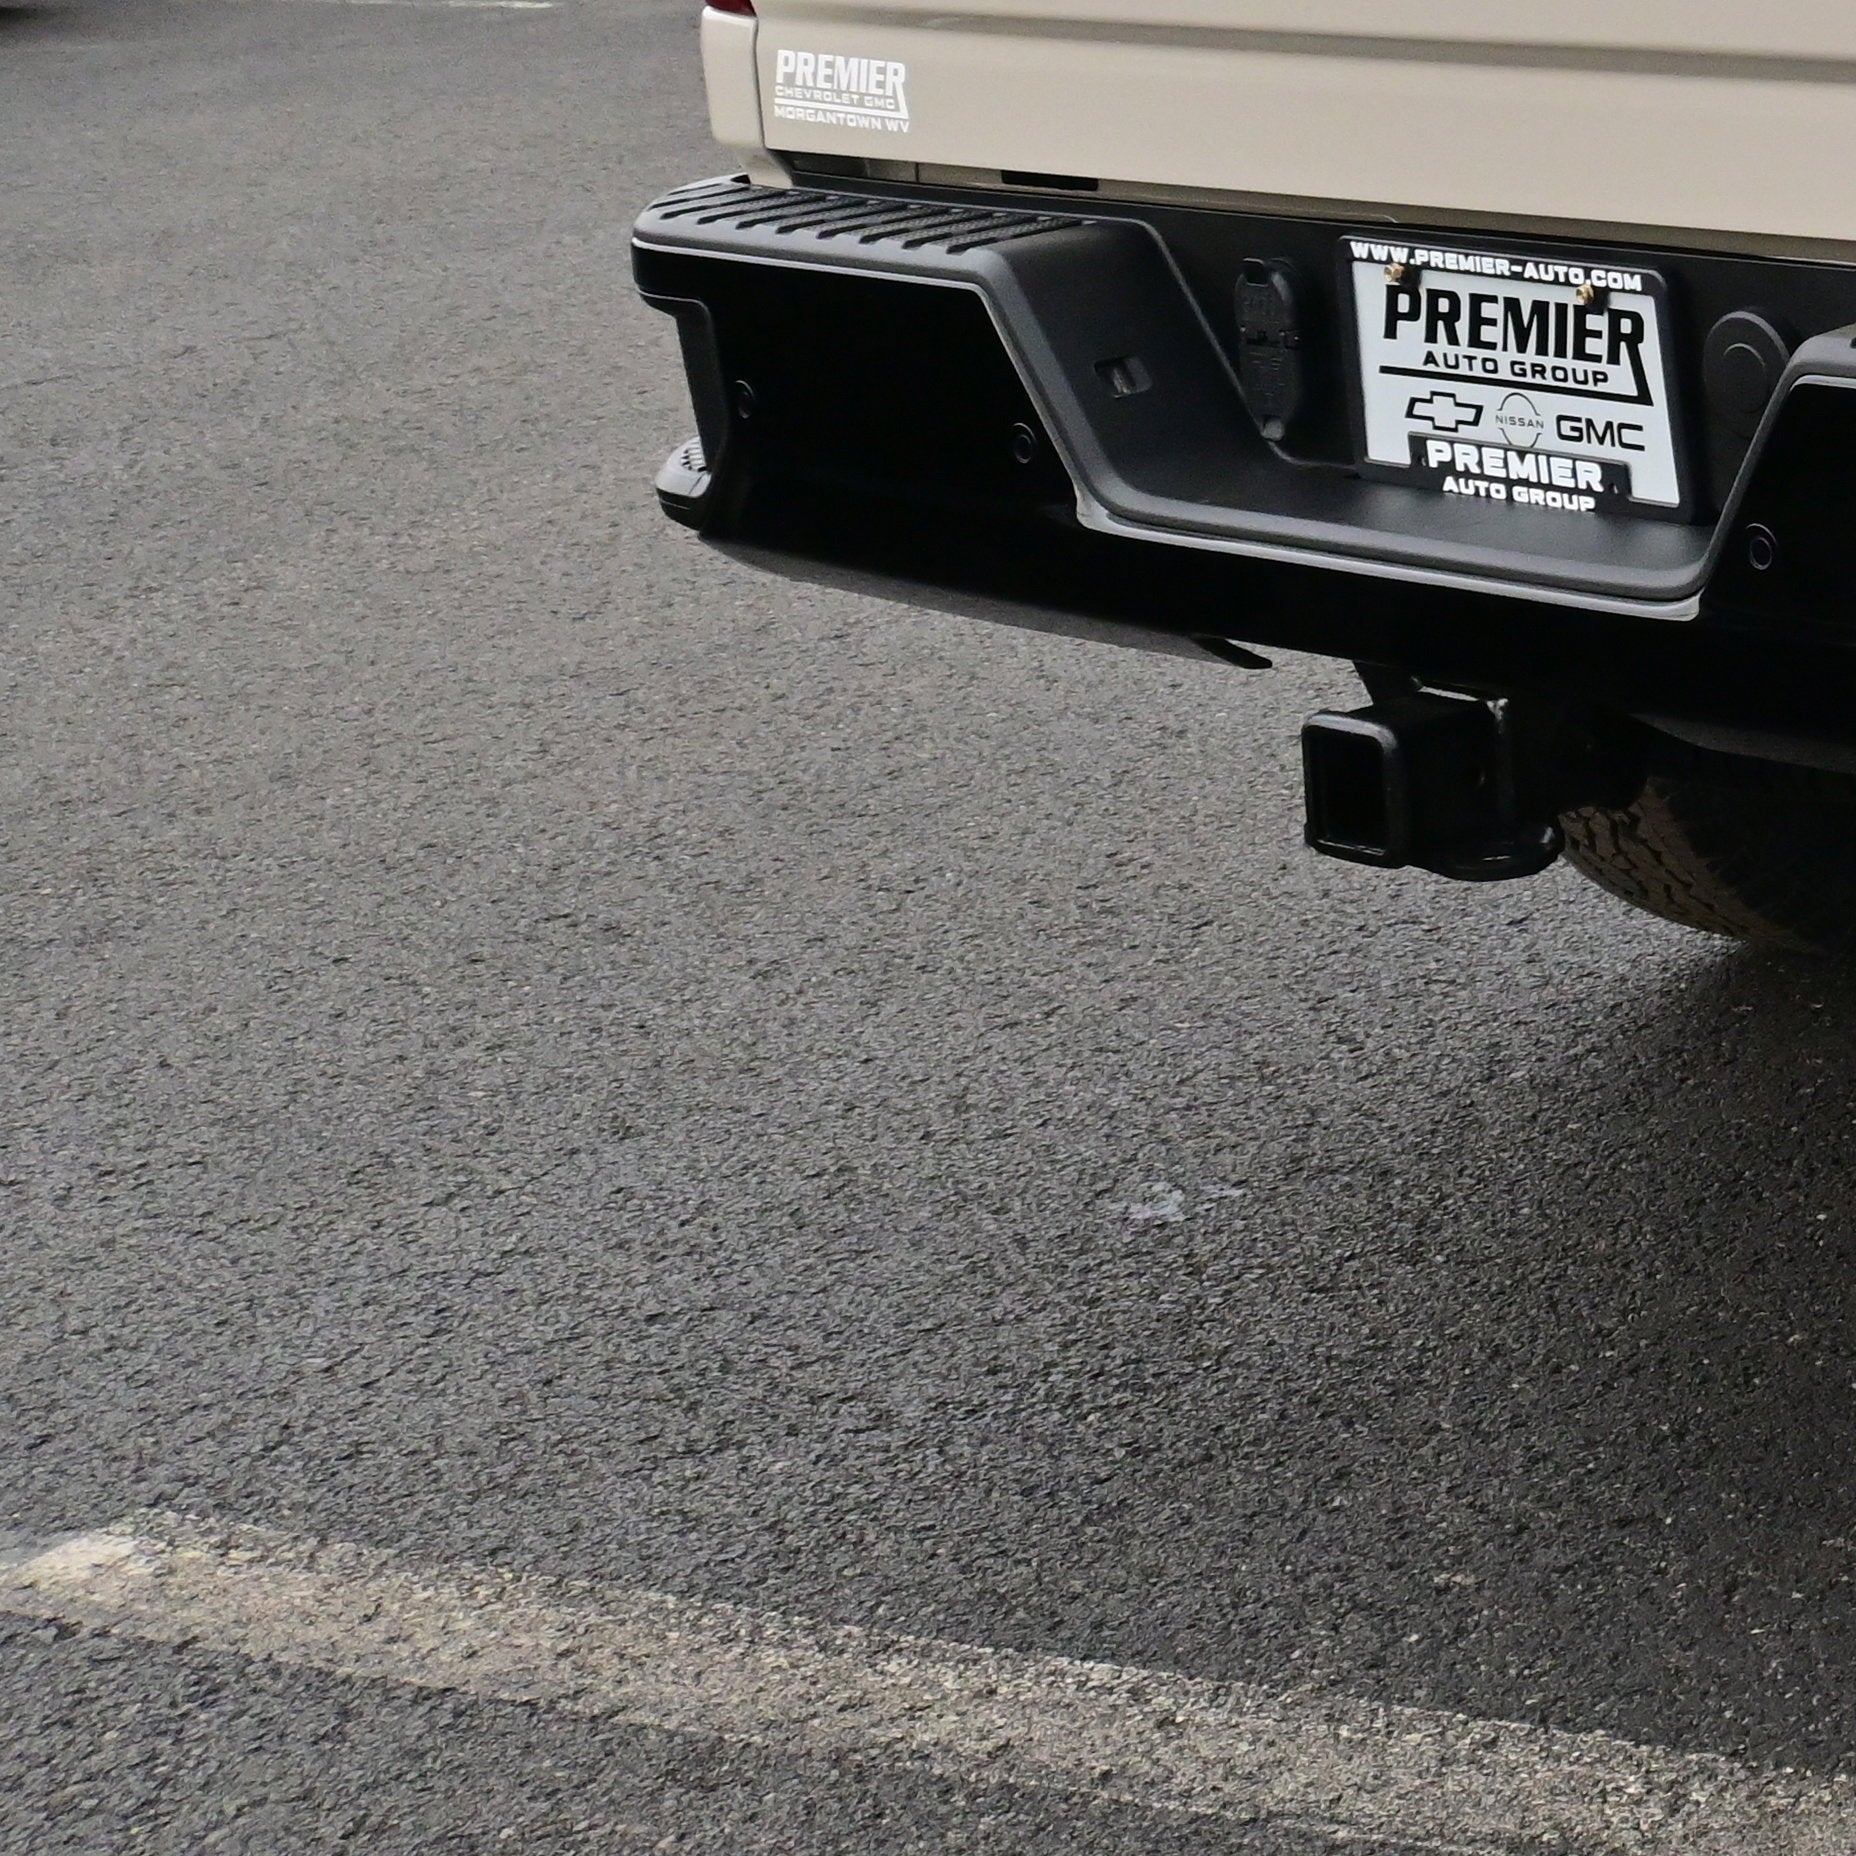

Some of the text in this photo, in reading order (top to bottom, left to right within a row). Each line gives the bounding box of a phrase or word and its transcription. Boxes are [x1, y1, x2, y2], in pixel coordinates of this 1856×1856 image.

[774, 85, 896, 110] CHEVROLET GMC
[775, 49, 909, 119] PREMIER
[774, 105, 910, 133] MORGANTOWN WV
[1350, 241, 1643, 292] WWW.PREMIER-AUTO.COM
[1383, 283, 1654, 407] PREMIER
[1422, 350, 1609, 388] AUTO GROUP
[1495, 414, 1646, 452] NISSAN GMC
[1426, 440, 1604, 493] PREMIER
[1442, 475, 1597, 513] AUTO GROUP
